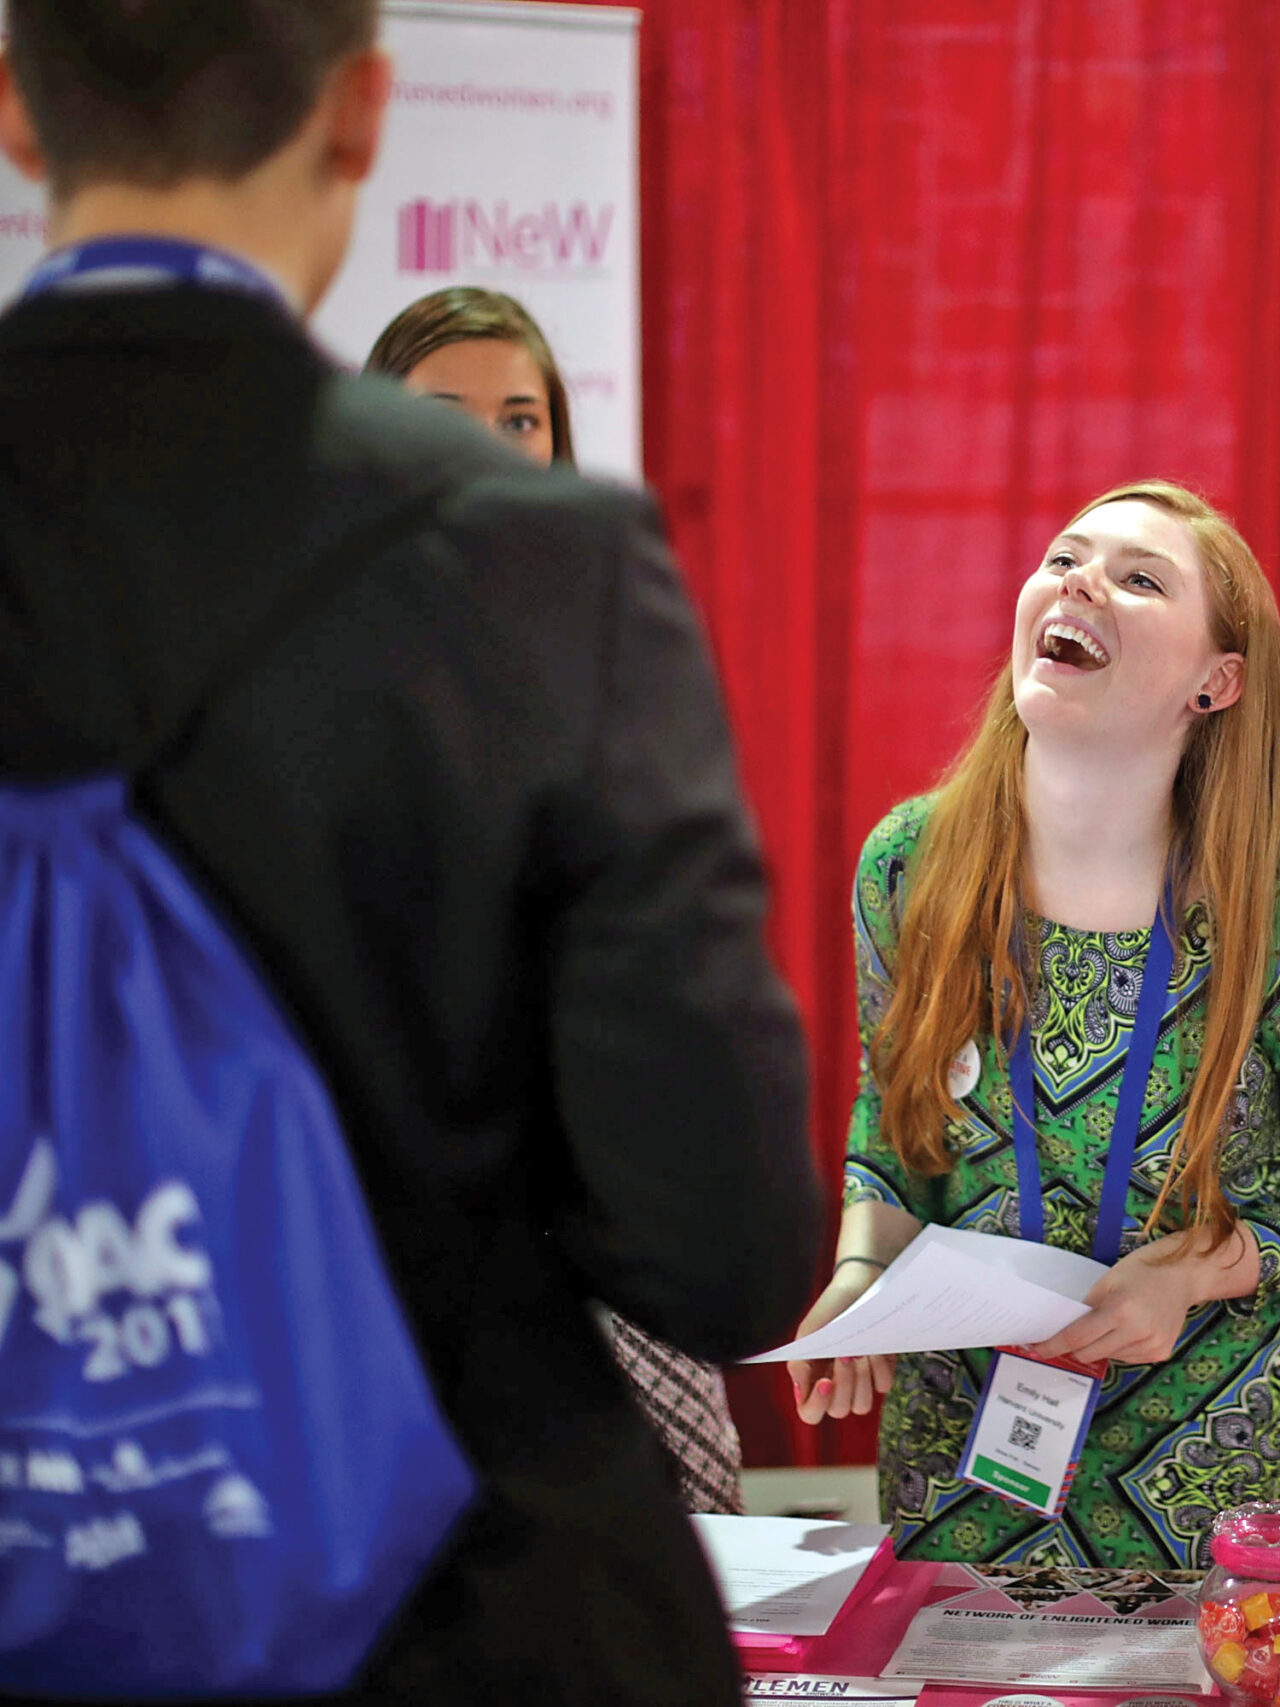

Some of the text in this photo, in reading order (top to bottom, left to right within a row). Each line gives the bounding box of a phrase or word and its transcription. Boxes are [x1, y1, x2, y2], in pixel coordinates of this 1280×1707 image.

[75, 1295, 212, 1383] 201
[1016, 1381, 1040, 1400] Emily
[1029, 1406, 1065, 1431] University
[943, 1609, 1197, 1626] NETWORK OF ENLIGHTENED WOME
